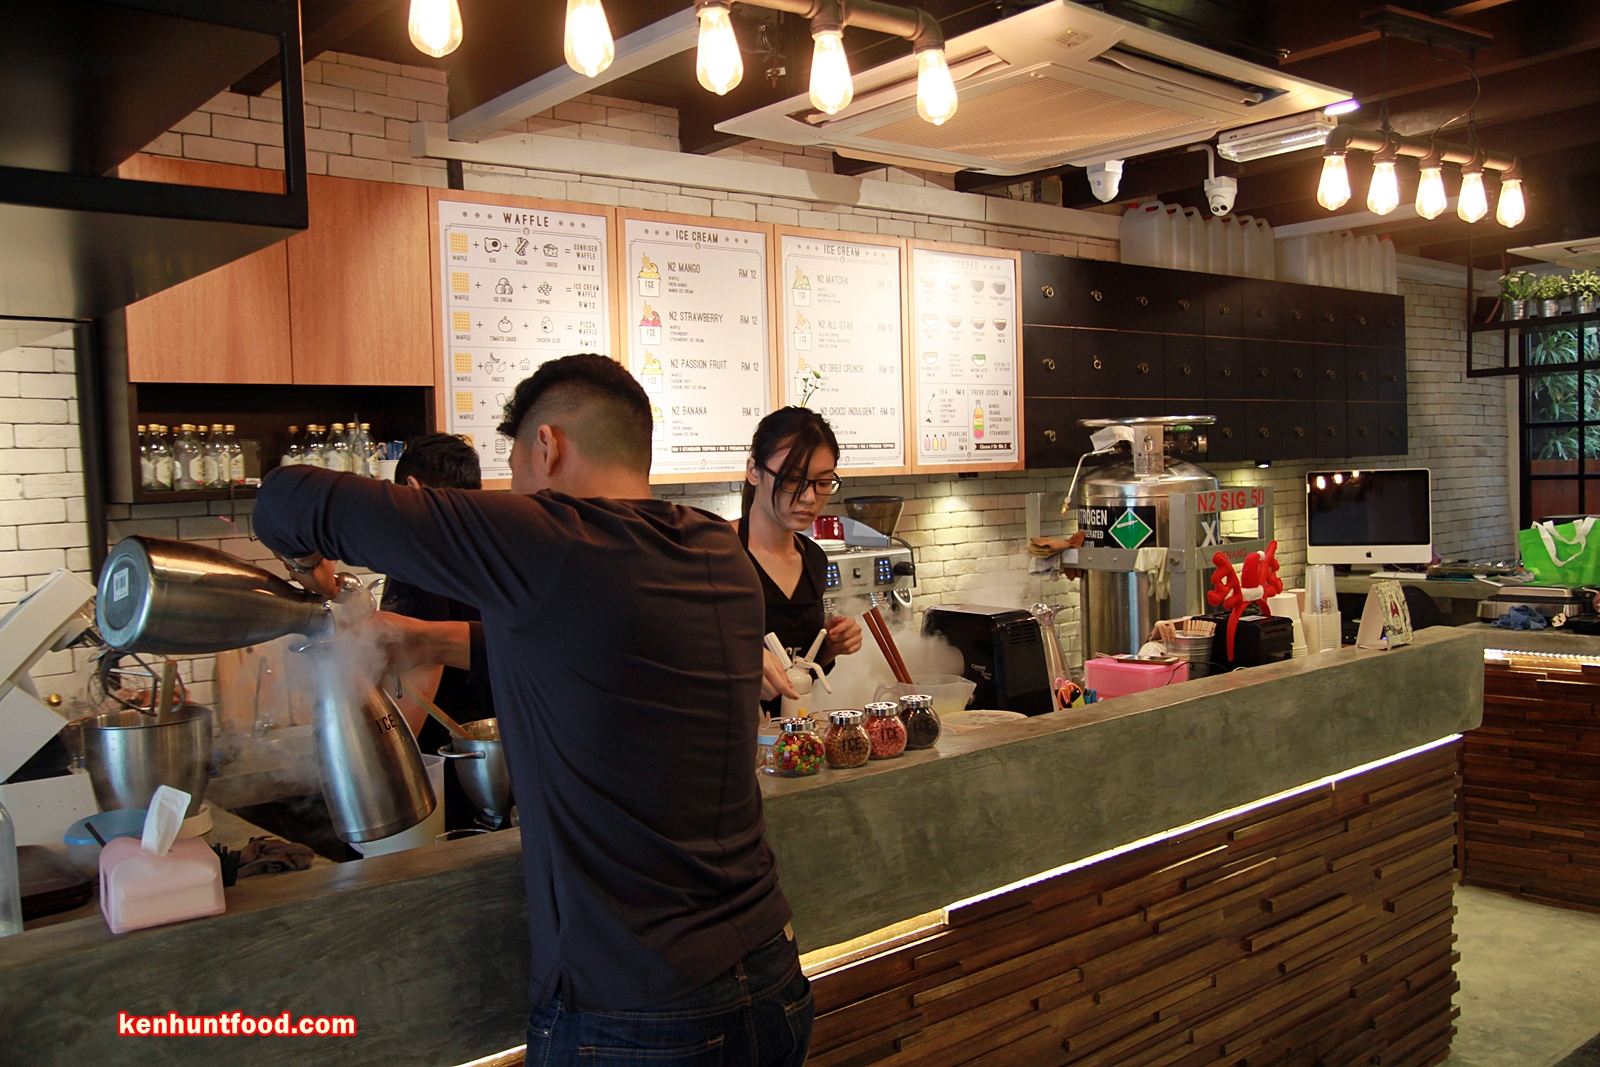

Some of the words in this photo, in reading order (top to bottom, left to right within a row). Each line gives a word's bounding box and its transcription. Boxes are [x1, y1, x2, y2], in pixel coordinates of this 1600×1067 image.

[502, 212, 549, 227] WAFFLE
[675, 229, 689, 240] ICE
[691, 231, 718, 243] CREAM
[824, 244, 835, 254] ICE
[838, 246, 860, 256] CREAM
[576, 252, 596, 260] WAFFLE
[668, 262, 677, 272] N2
[678, 263, 700, 274] MANGO
[738, 268, 748, 278] RM
[750, 270, 756, 279] 12
[816, 274, 824, 284] N2
[826, 276, 848, 285] MATCHA
[669, 311, 677, 321] N2
[680, 312, 723, 323] STRAWBERRY
[740, 315, 749, 324] RM
[752, 316, 757, 325] 12
[818, 320, 825, 329] N2
[827, 321, 837, 329] ALL
[839, 321, 853, 330] STAR
[671, 359, 678, 368] N2
[681, 359, 707, 369] PASSION
[710, 360, 727, 370] FRUIT
[741, 362, 750, 371] RM
[753, 363, 759, 372] 12
[819, 363, 826, 372] N2
[828, 364, 842, 372] OREO
[844, 364, 864, 373] CRUNCH
[879, 365, 887, 374] RM
[672, 406, 680, 416] N2
[682, 407, 707, 416] BANANA
[742, 407, 751, 416] RM
[754, 408, 760, 416] 12
[829, 407, 846, 416] CHOCO
[848, 407, 875, 416] INDULGENT
[880, 407, 888, 416] RM
[890, 408, 895, 416] 13
[1197, 494, 1216, 512] N2
[1220, 491, 1246, 511] SIG
[1250, 488, 1265, 508] 50
